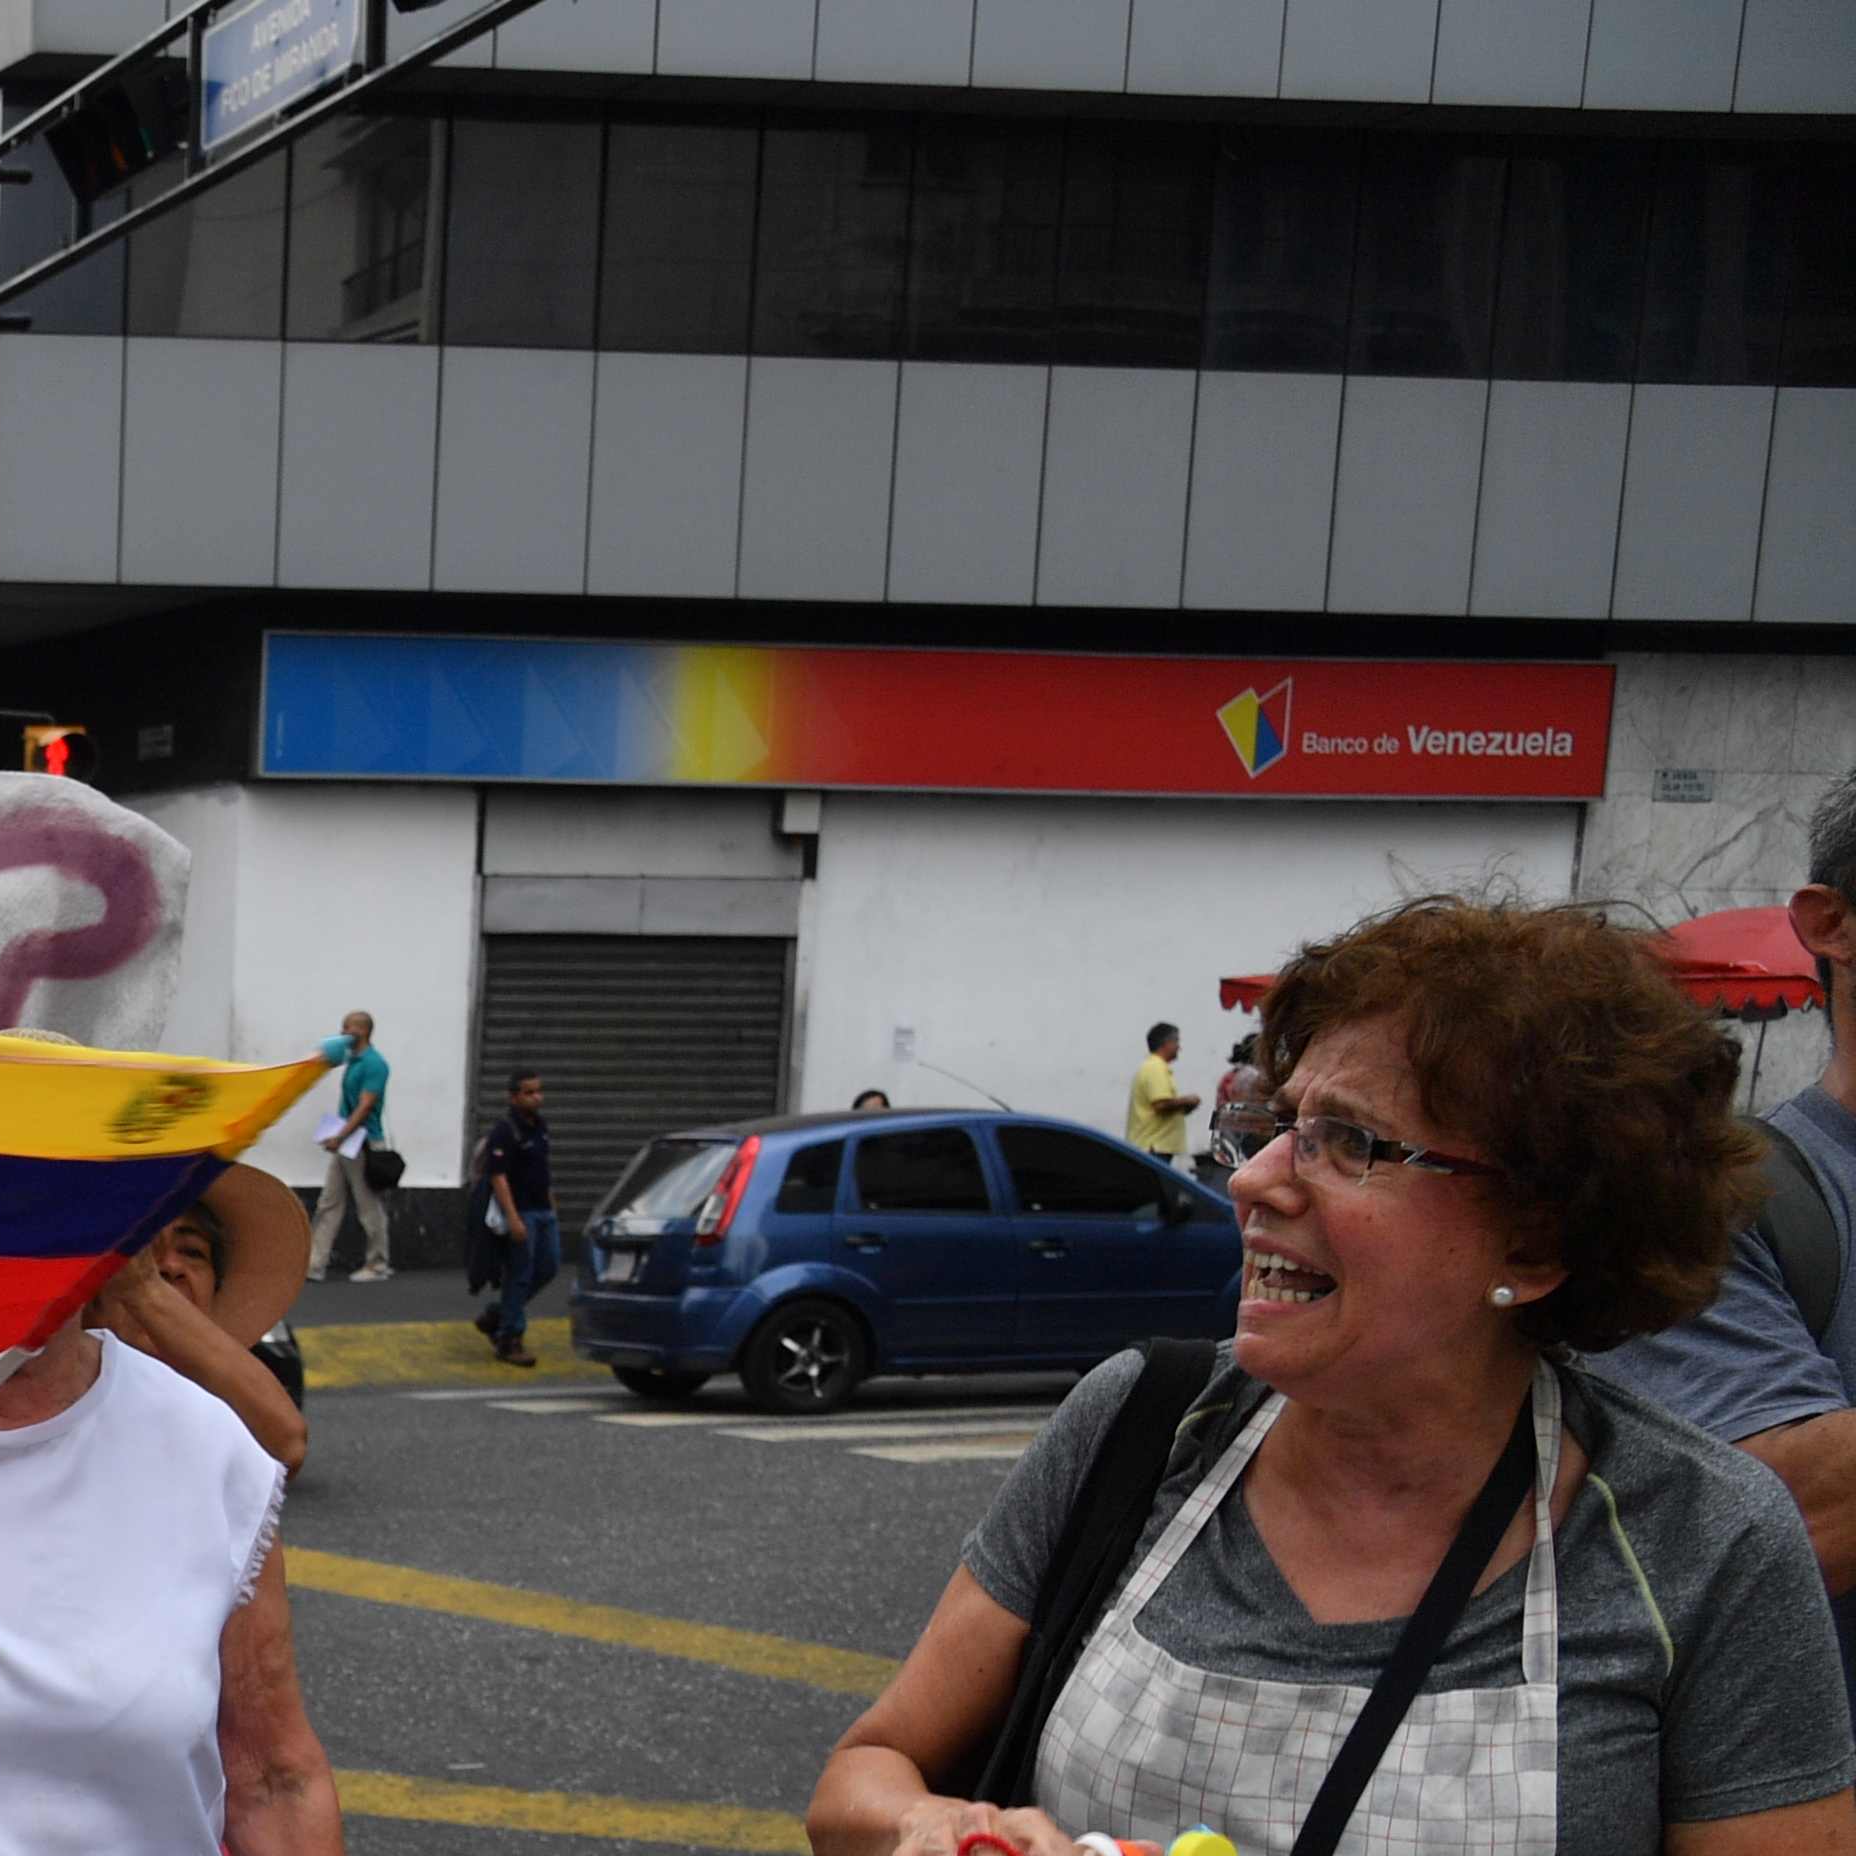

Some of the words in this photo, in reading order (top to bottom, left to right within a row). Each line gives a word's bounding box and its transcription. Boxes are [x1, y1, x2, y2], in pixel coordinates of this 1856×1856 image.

[1301, 731, 1368, 755] Banco
[1373, 732, 1400, 755] de
[1407, 724, 1574, 757] Venezuela
